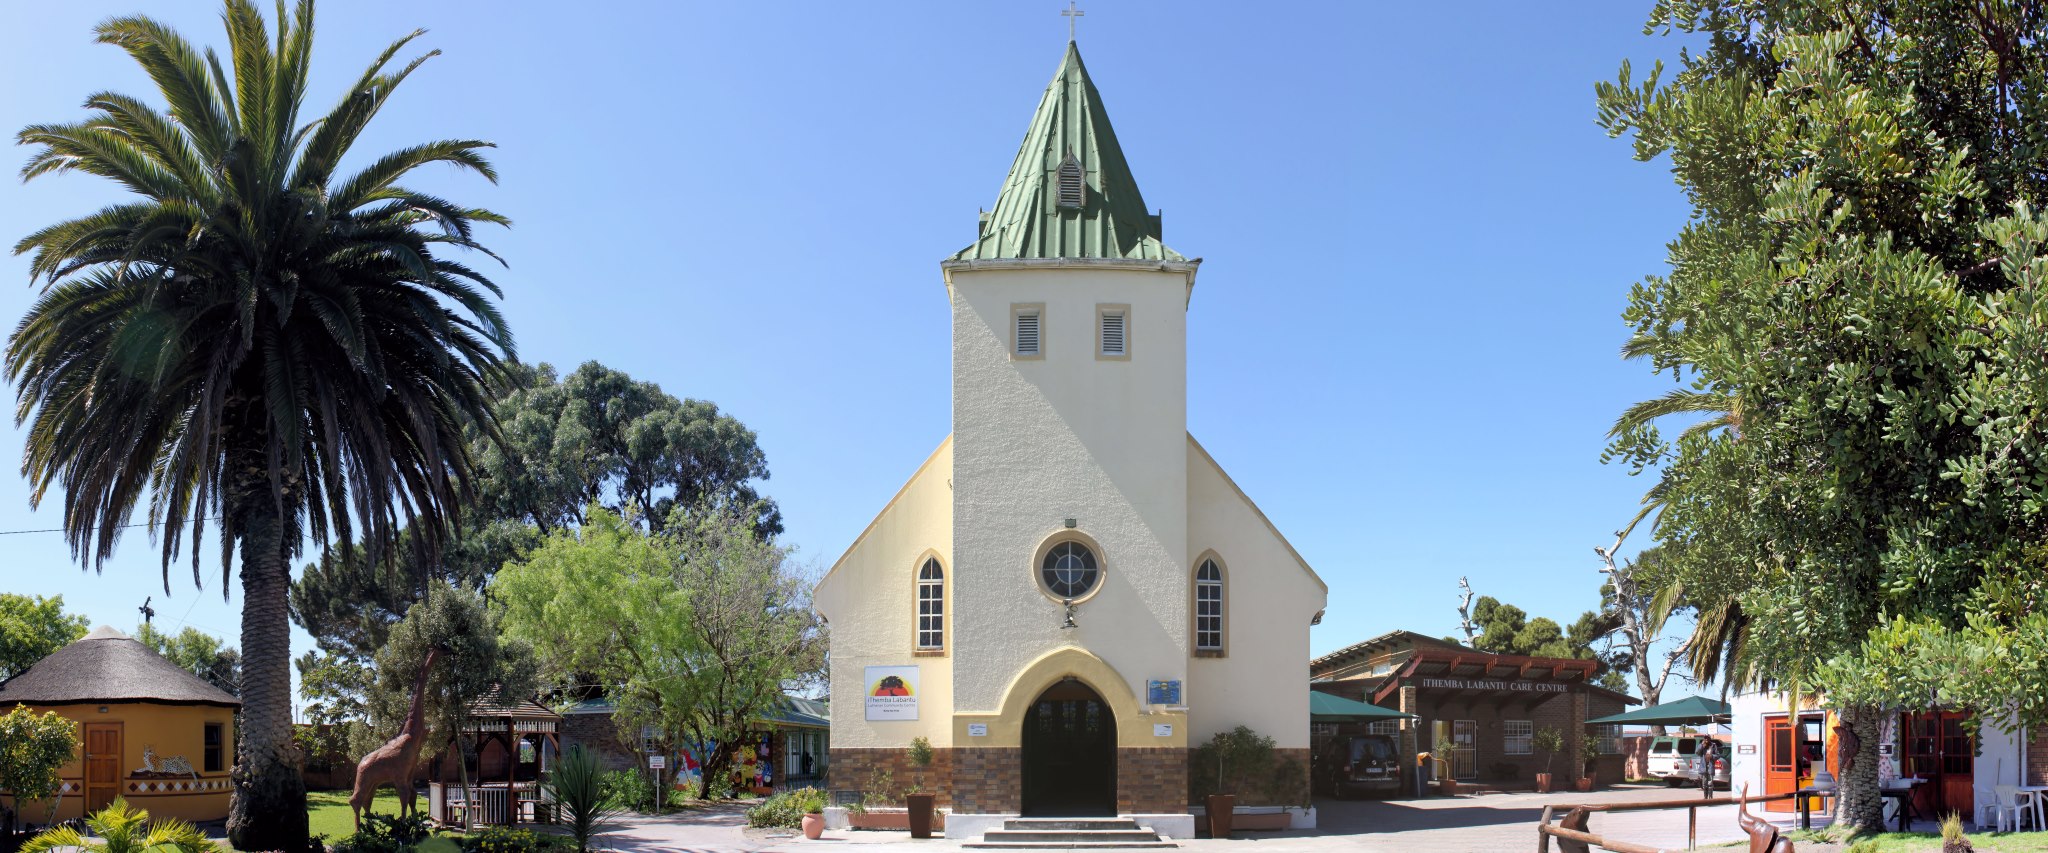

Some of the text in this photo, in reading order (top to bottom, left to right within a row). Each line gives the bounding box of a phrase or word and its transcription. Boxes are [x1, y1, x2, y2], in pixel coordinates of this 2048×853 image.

[1467, 680, 1507, 690] LABANTU
[1510, 682, 1533, 692] CARE
[1536, 683, 1568, 693] CENTRE
